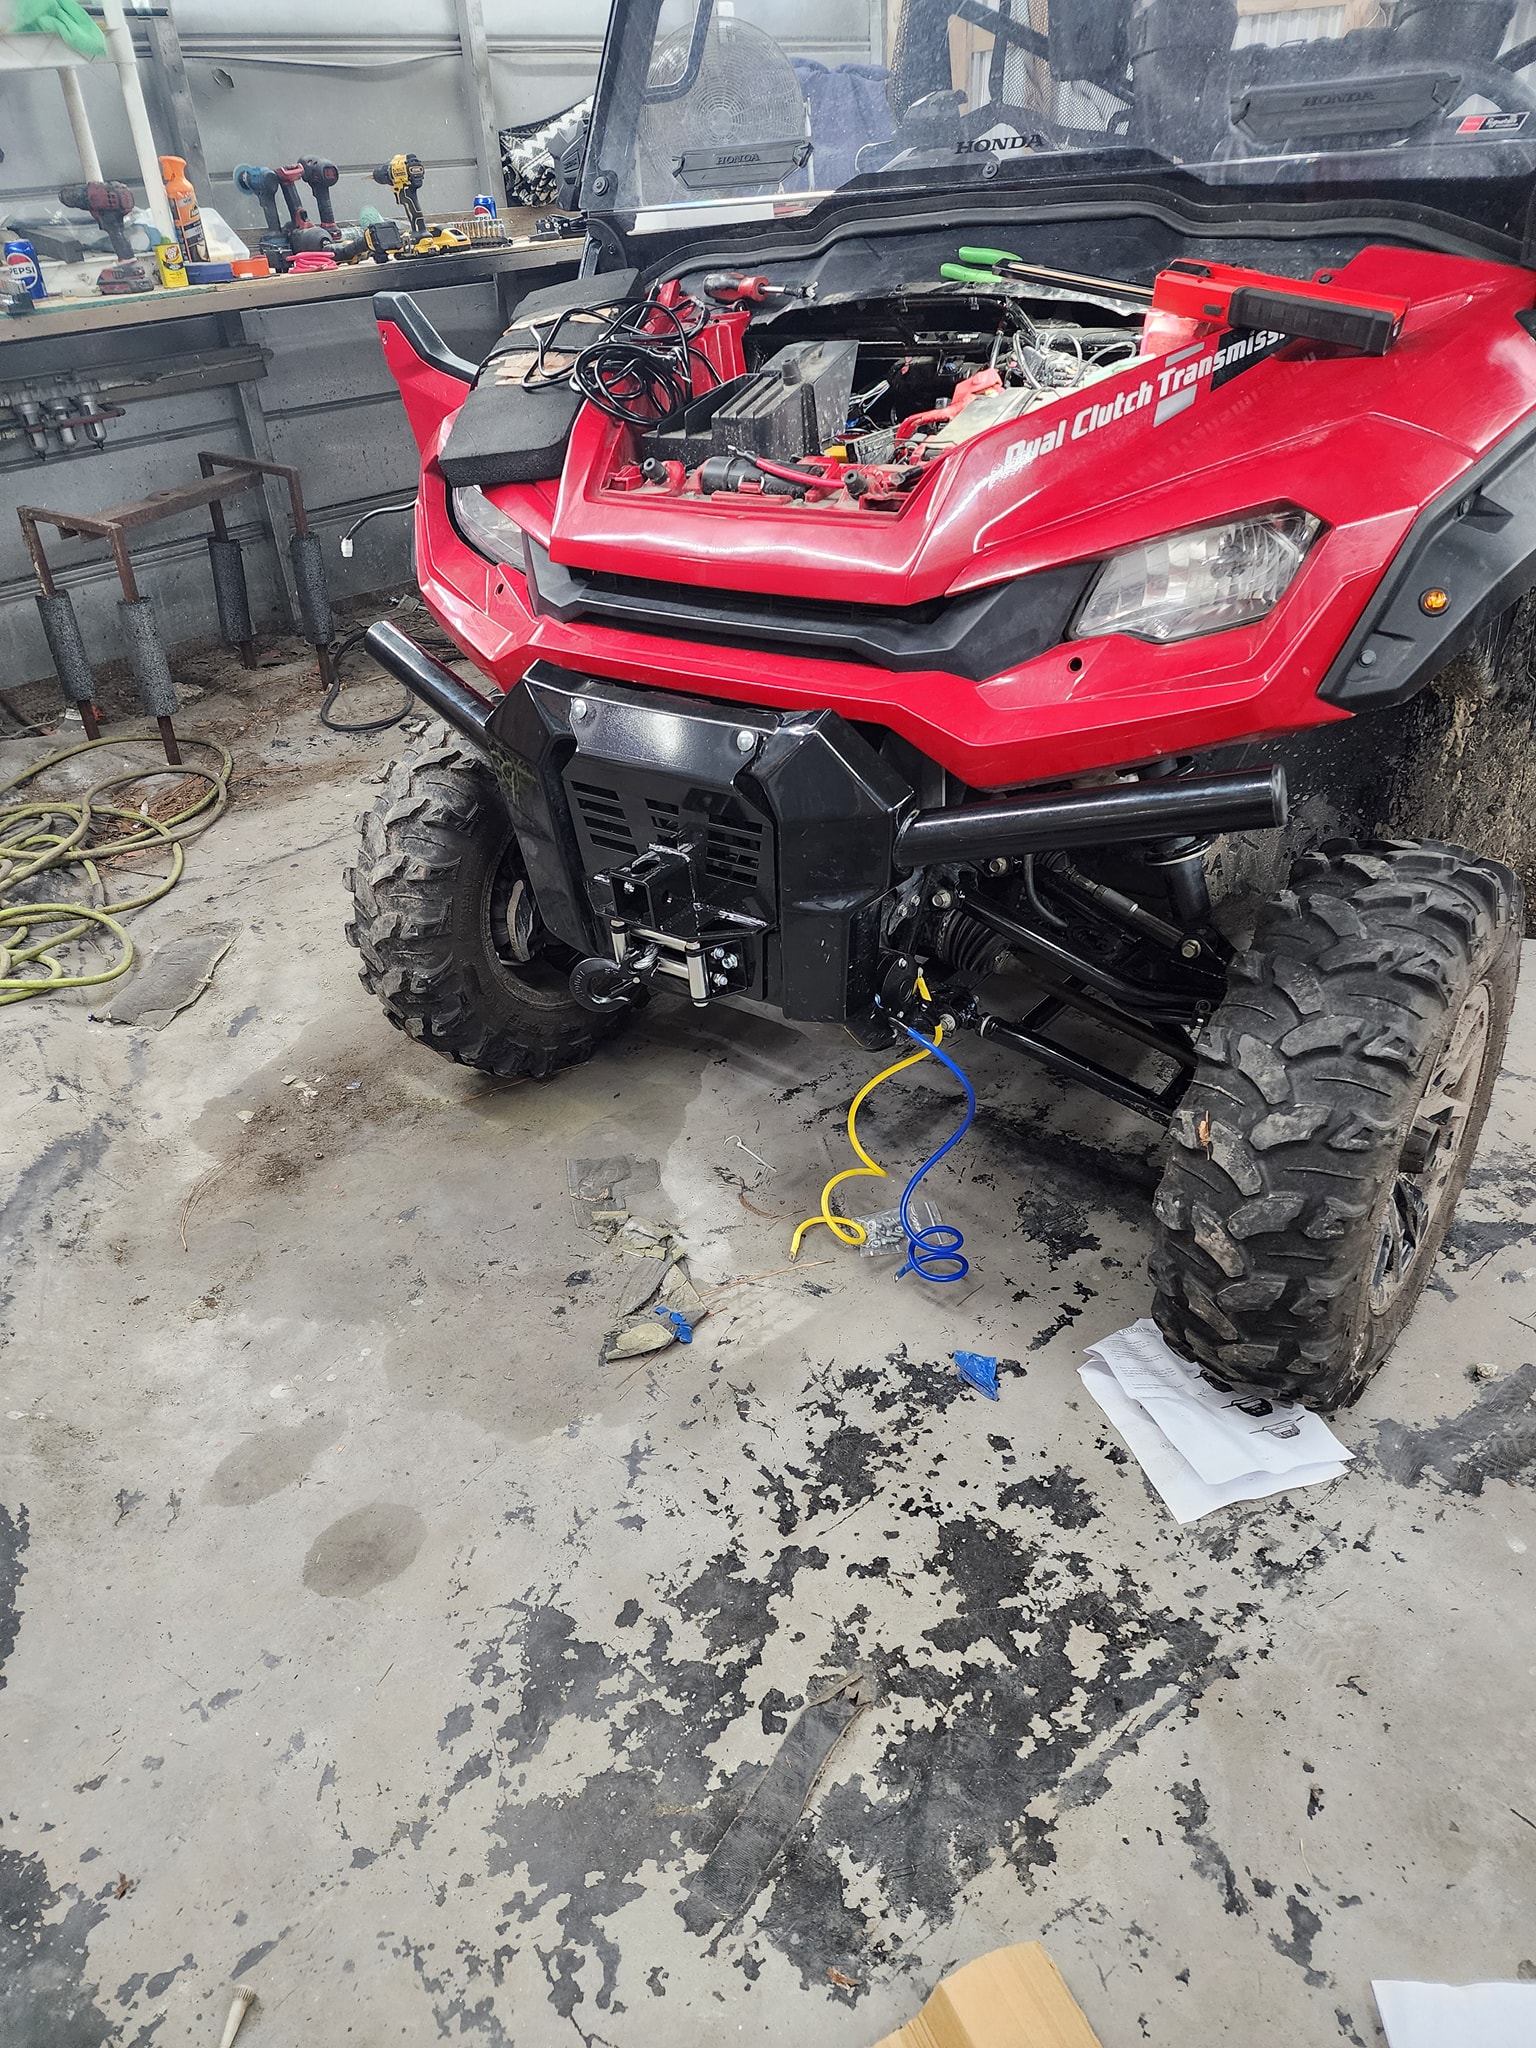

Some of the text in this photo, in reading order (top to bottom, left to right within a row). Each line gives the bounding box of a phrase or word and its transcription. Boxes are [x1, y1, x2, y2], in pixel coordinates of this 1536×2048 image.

[954, 133, 1045, 155] HONDA
[715, 152, 761, 166] HONDA
[1003, 329, 1286, 473] Dual Clutch Transmiss
